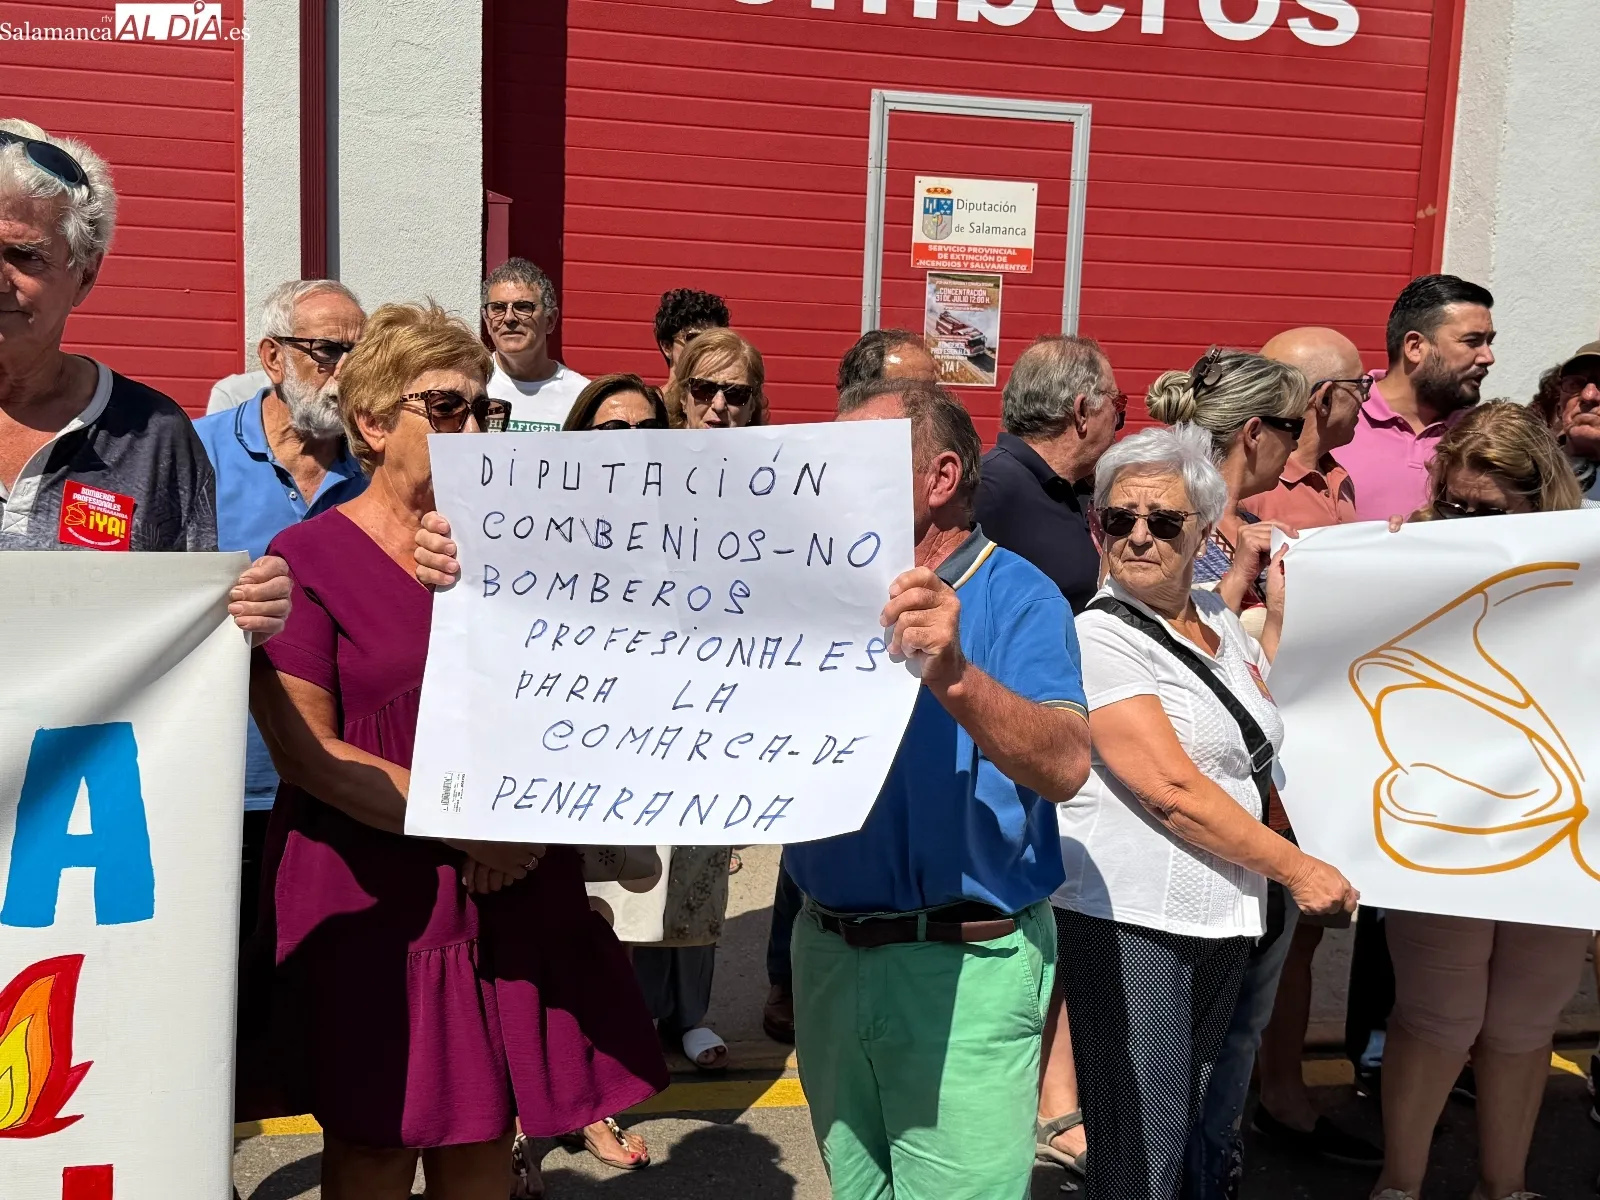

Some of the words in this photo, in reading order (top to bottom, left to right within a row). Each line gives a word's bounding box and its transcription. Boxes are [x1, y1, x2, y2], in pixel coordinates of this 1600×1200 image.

[956, 199, 1017, 213] Diputación
[955, 224, 965, 233] de
[969, 222, 1026, 236] Salamanca
[928, 245, 966, 253] SERVICIO
[968, 247, 1017, 256] PROVINCIAL
[950, 254, 995, 262] EXTINCIÓN
[970, 263, 1028, 271] SALVAMENTO
[952, 295, 969, 303] JULIO
[89, 511, 126, 538] ¡YA!
[483, 564, 751, 614] BOMBEROS
[515, 669, 618, 704] PARA
[671, 679, 739, 713] LA
[492, 775, 795, 831] PENARANDA
